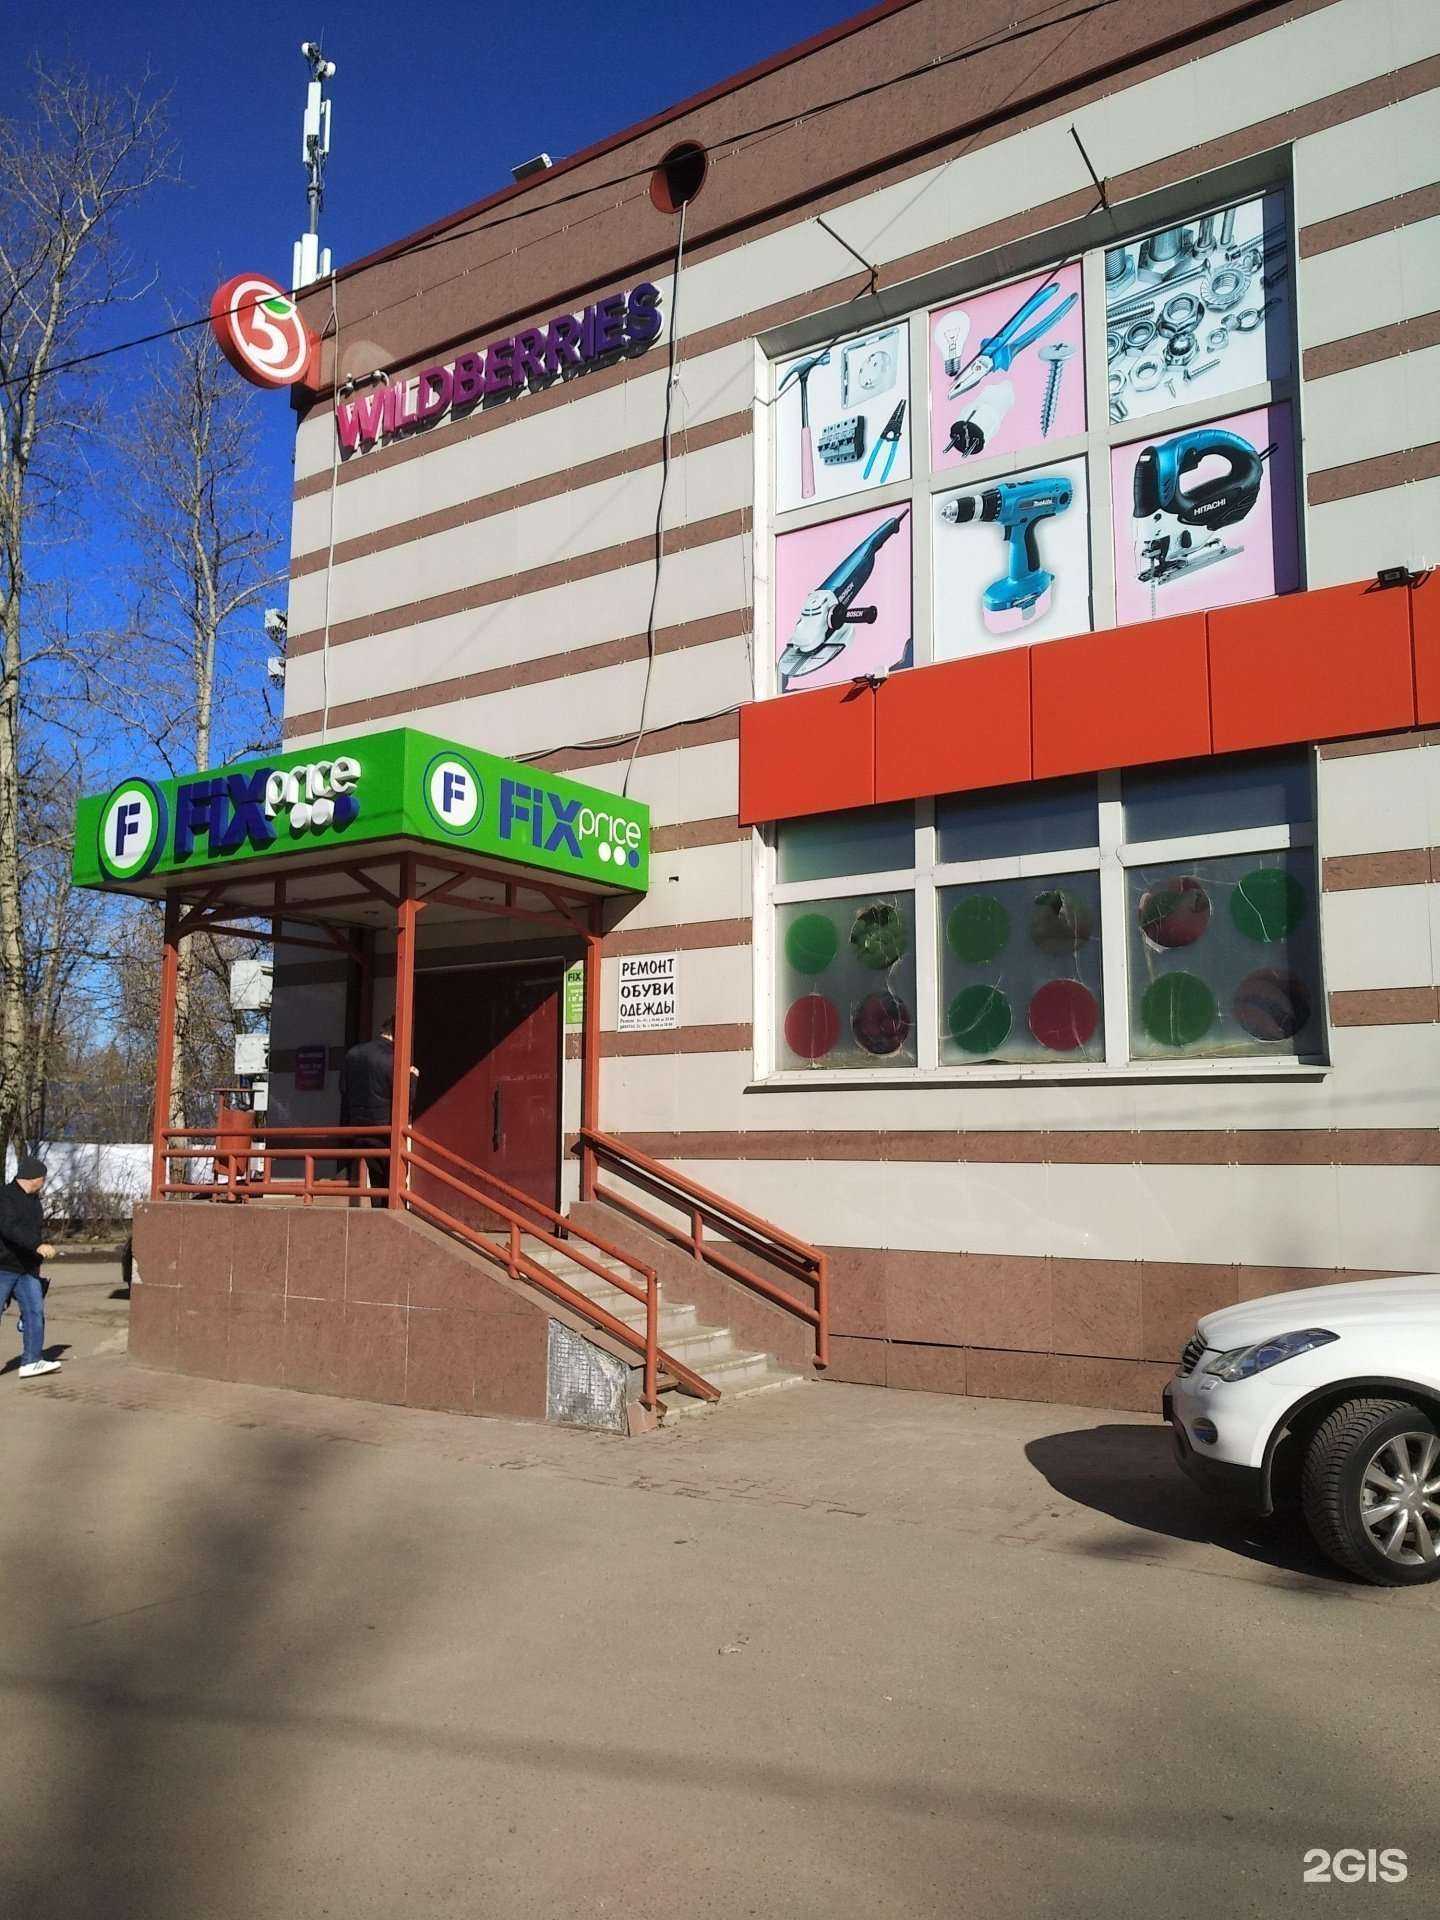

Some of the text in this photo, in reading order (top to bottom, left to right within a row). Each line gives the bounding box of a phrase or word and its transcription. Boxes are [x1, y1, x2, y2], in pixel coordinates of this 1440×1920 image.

[336, 282, 663, 449] WILDBERRIES
[1193, 498, 1226, 516] HITACHI
[115, 802, 141, 857] F
[265, 756, 361, 816] price
[443, 771, 466, 813] F
[579, 808, 641, 848] price
[622, 959, 675, 976] РЕМОНТ
[621, 982, 674, 998] ОБУВИ
[620, 1000, 675, 1017] ОДЕЖДЫ
